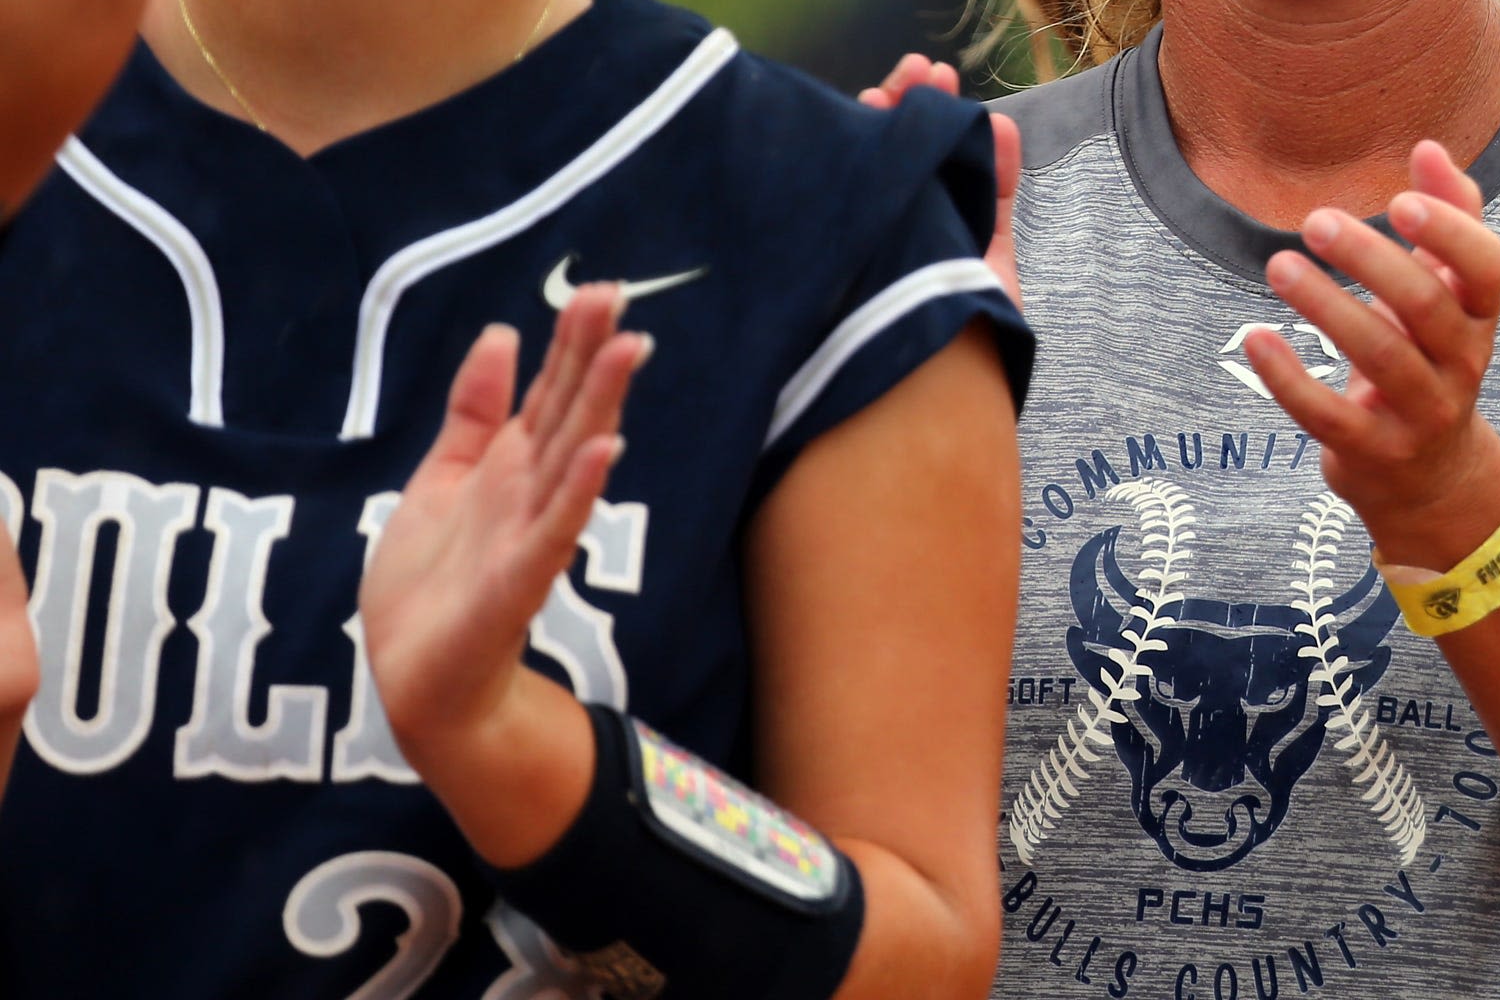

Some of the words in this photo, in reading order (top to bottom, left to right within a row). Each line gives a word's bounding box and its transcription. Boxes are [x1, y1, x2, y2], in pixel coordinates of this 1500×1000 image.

[1021, 432, 1310, 549] COMMUNIT
[0, 468, 648, 783] ULS
[1376, 695, 1462, 732] BALL
[1002, 871, 1137, 999] BULLS
[1174, 871, 1425, 1000] COUNTRY
[1135, 887, 1266, 930] PCHS
